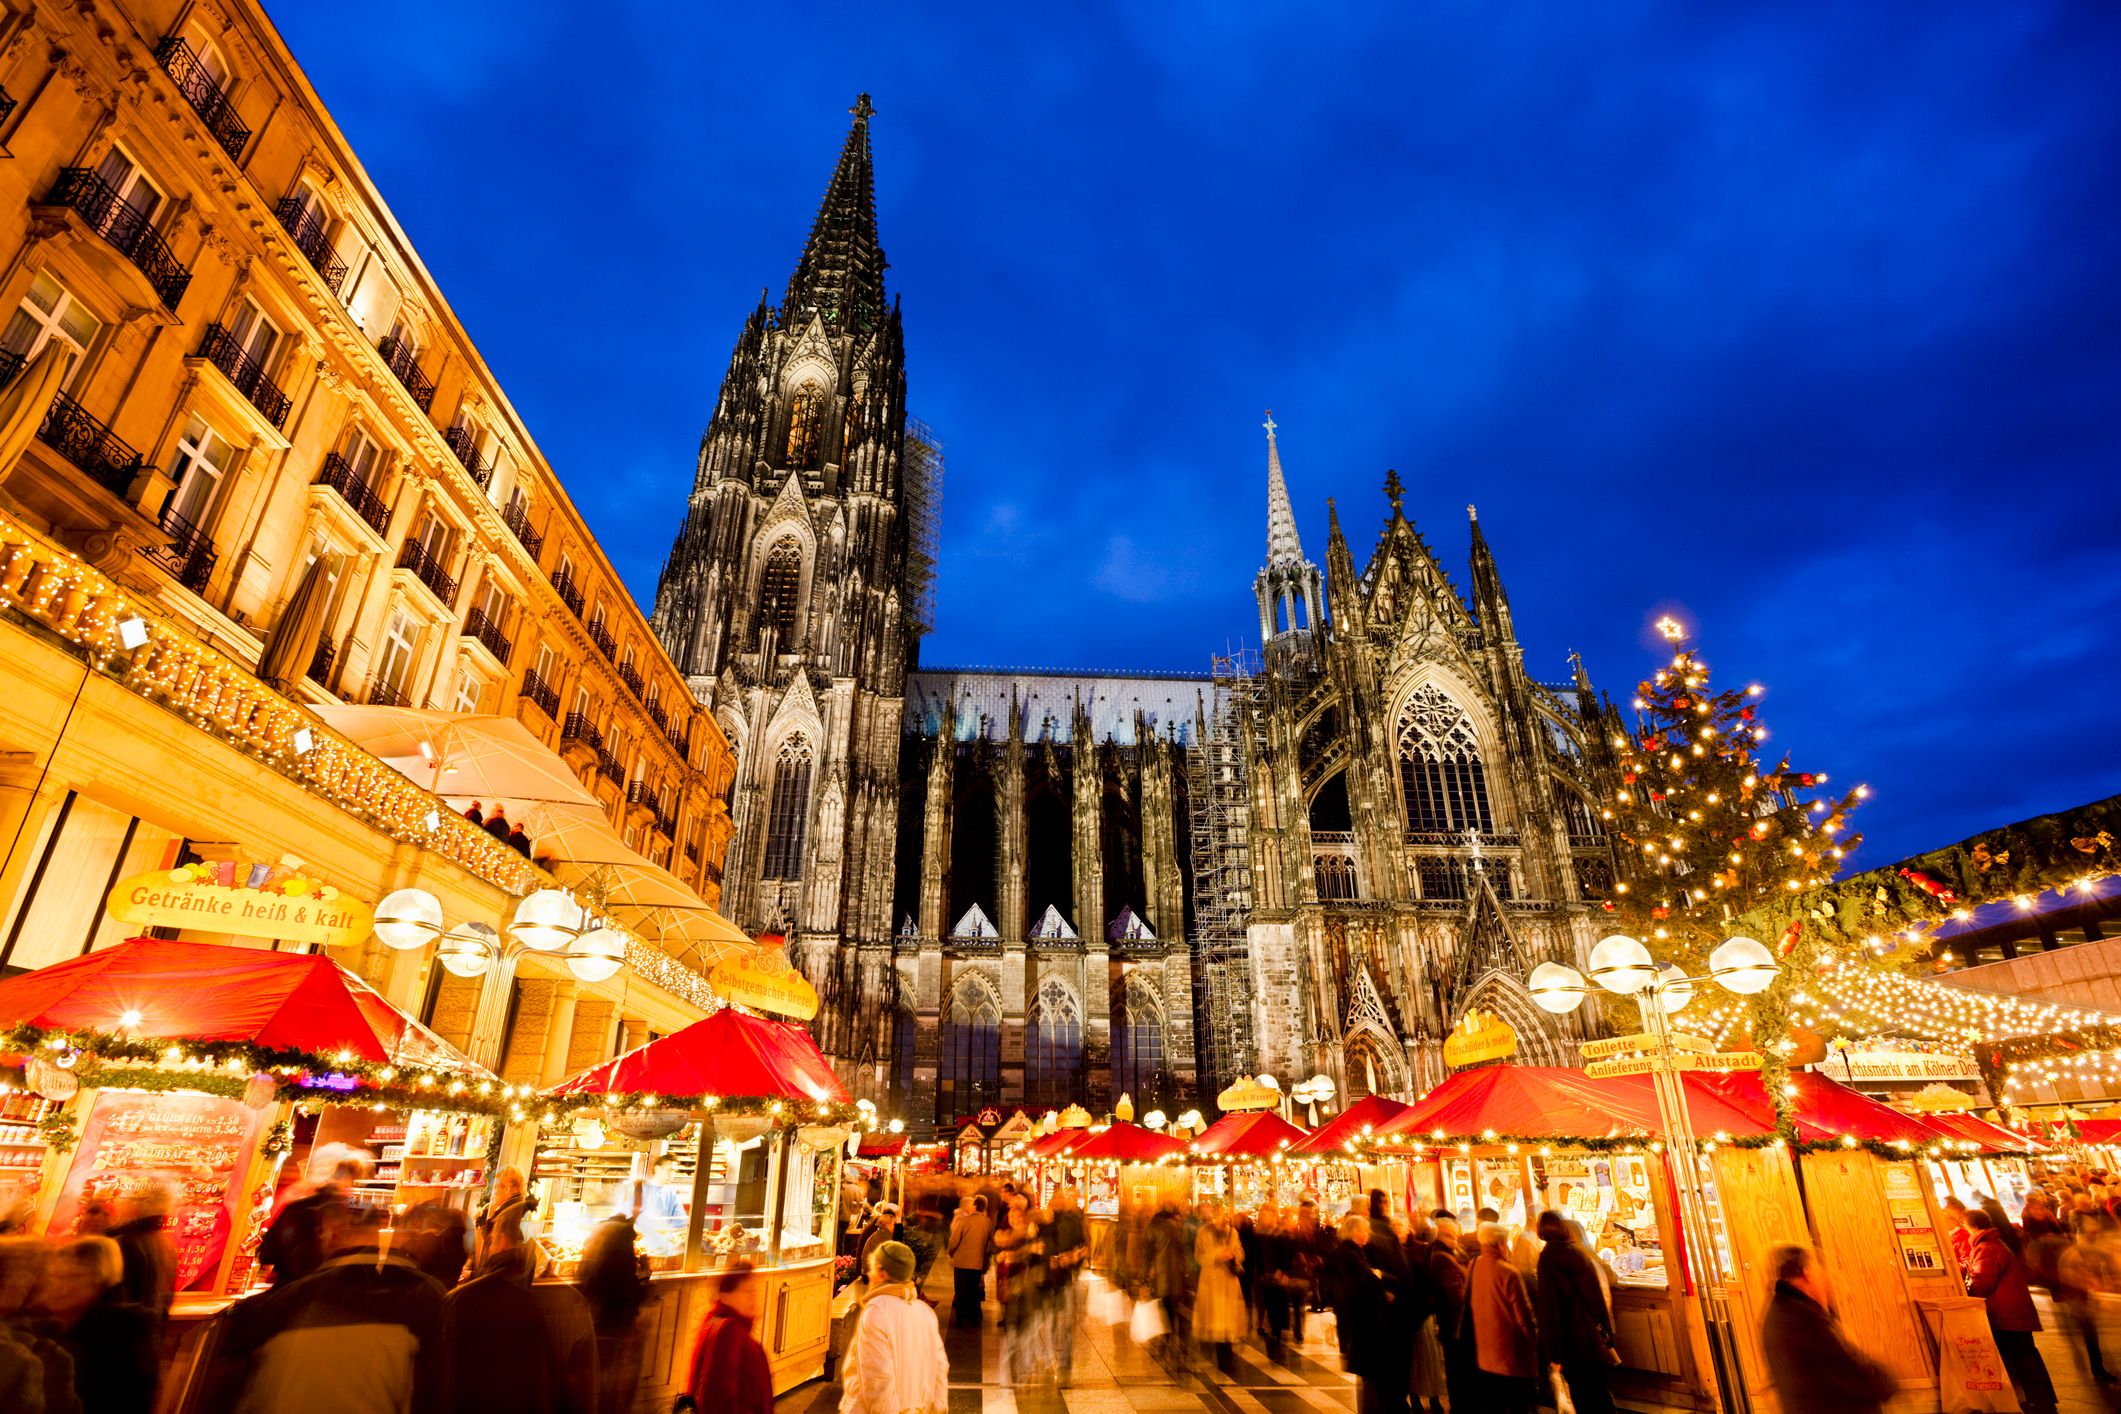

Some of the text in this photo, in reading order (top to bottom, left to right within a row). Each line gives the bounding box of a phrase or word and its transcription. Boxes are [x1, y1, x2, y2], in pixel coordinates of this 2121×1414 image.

[130, 886, 354, 930] Getränke heiß & kalt
[718, 970, 813, 1008] Selbstgemachte Brezel
[1448, 1041, 1485, 1056] Türschilder
[1492, 1034, 1510, 1046] mehr
[1584, 1040, 1636, 1055] Toilette
[1590, 1060, 1652, 1077] Anlieferung
[1694, 1055, 1758, 1068] Altstadt
[1905, 1065, 1921, 1076] am
[1923, 1059, 1957, 1076] Kölner
